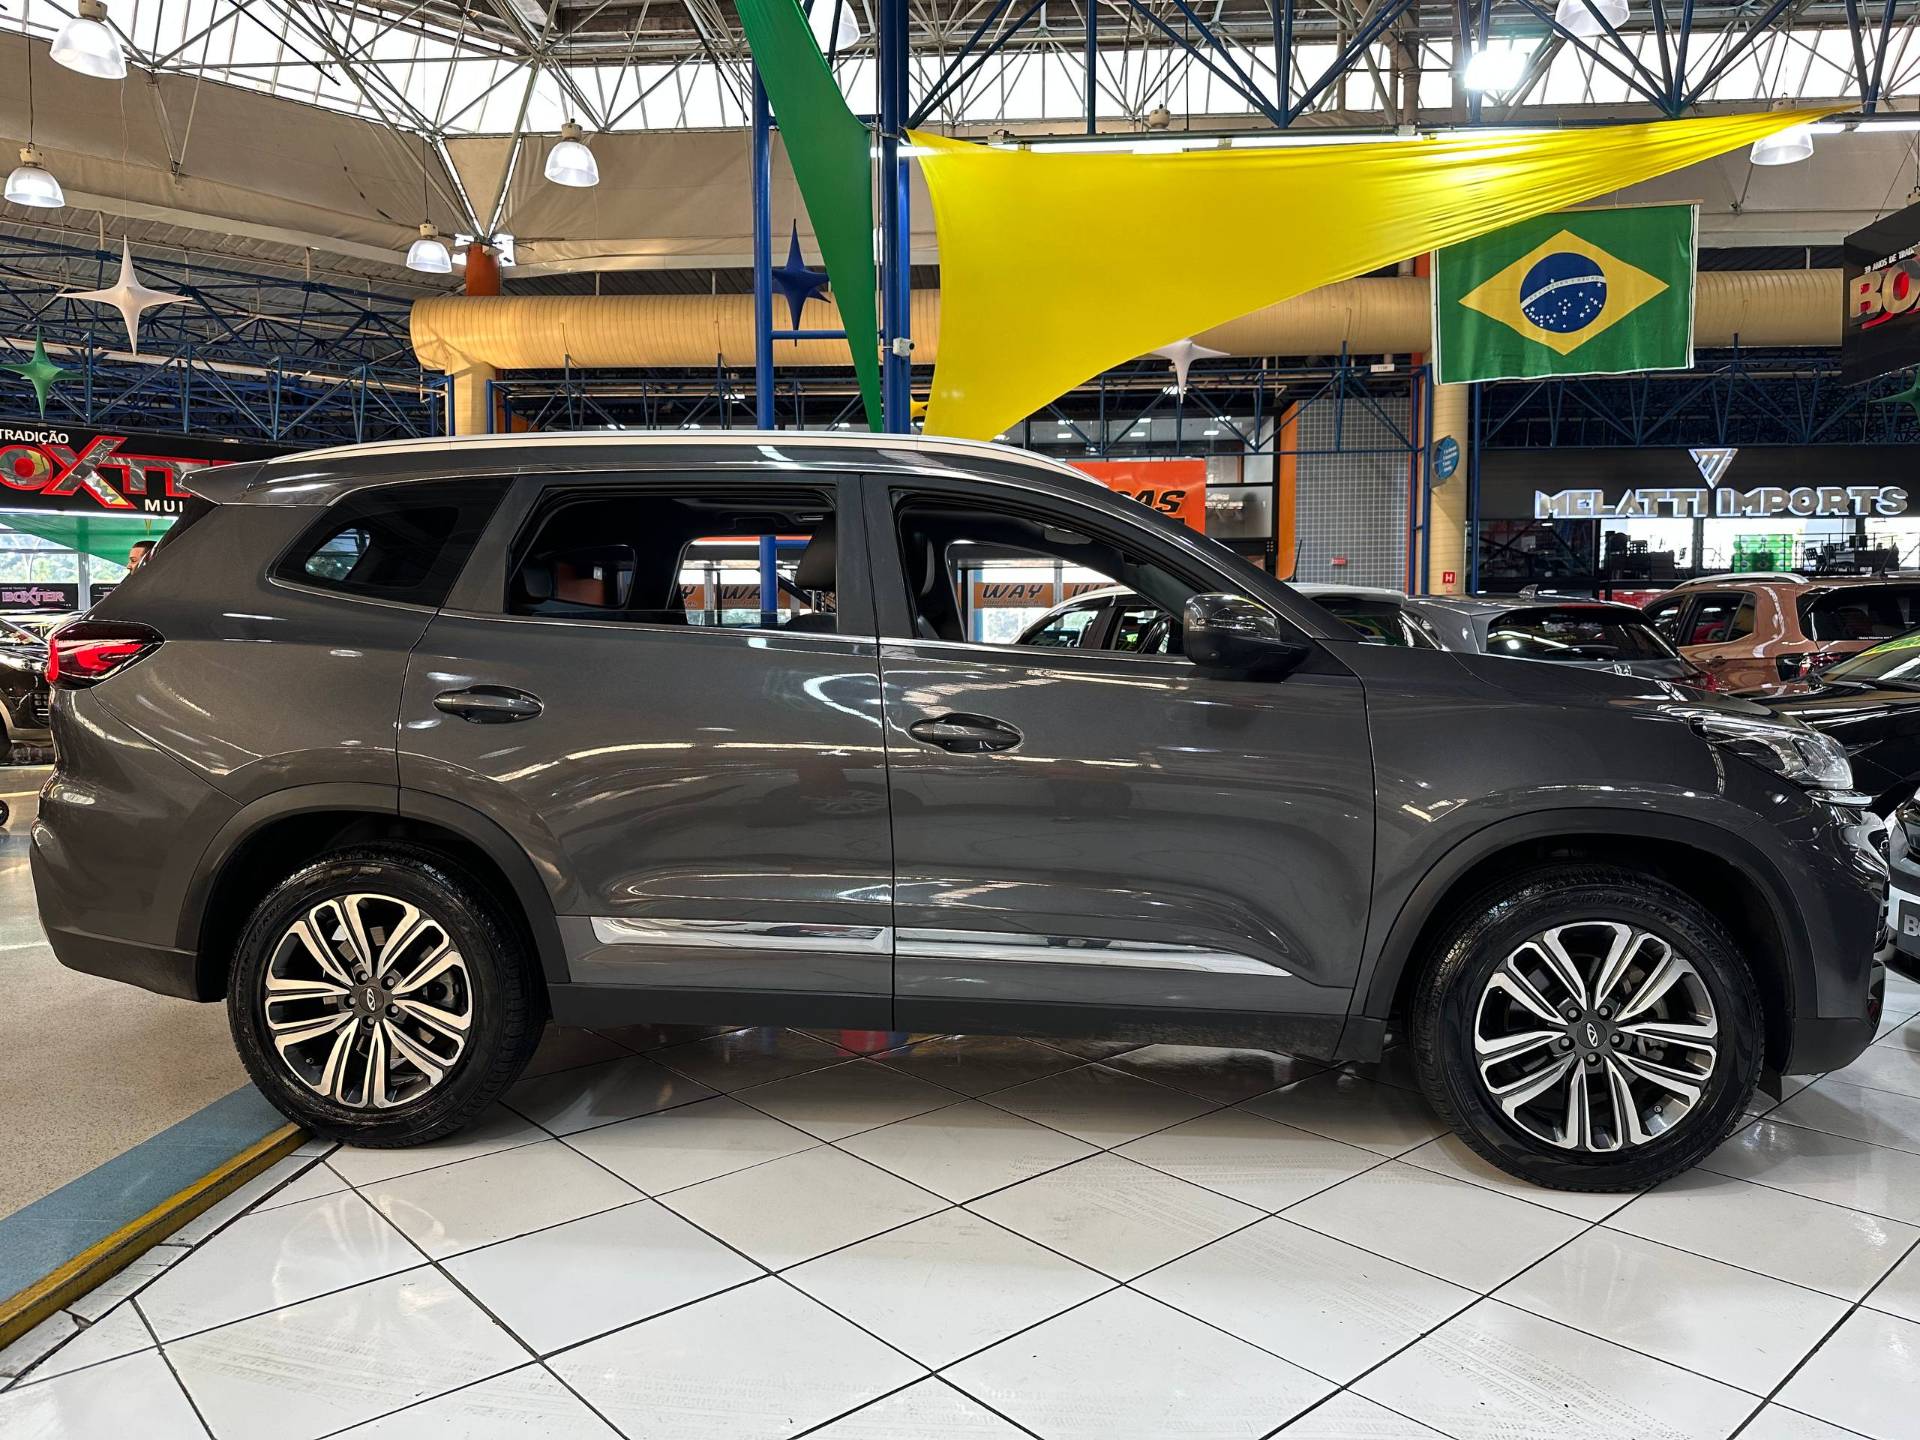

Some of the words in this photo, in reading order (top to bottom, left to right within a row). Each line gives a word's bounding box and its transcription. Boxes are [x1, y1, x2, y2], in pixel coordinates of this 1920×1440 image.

[1117, 489, 1187, 513] AS
[1535, 488, 1709, 519] MELATTI
[1716, 486, 1909, 517] IMPORTS
[2, 586, 66, 606] BOXTER
[982, 584, 1044, 599] WAY
